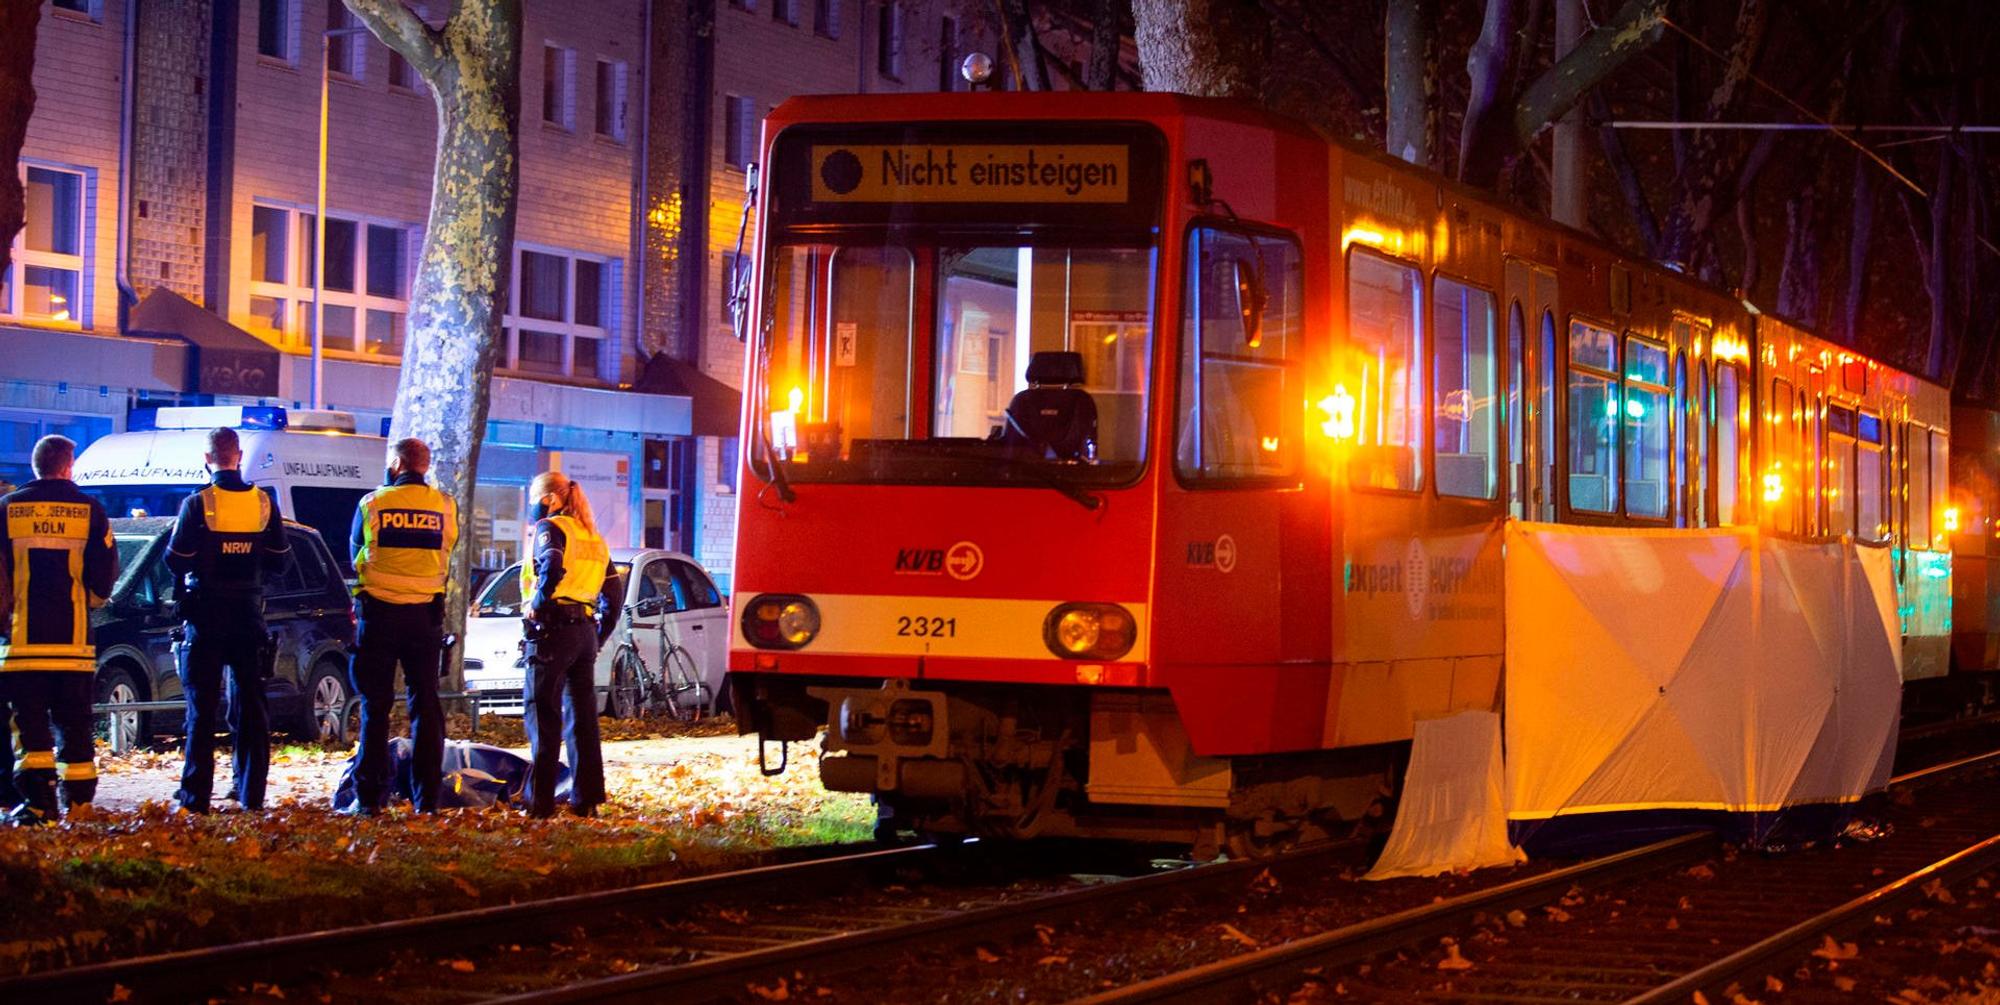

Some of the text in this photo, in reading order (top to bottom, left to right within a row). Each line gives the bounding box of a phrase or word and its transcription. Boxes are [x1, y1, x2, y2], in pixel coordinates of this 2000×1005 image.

[881, 149, 1117, 195] Nicht einsteigen
[282, 461, 361, 479] UNFALLAUFNAHME
[382, 512, 441, 530] POLIZEI
[222, 541, 253, 555] NRW
[1186, 543, 1214, 565] KVB
[896, 549, 944, 571] KVB
[897, 615, 957, 638] 2321
